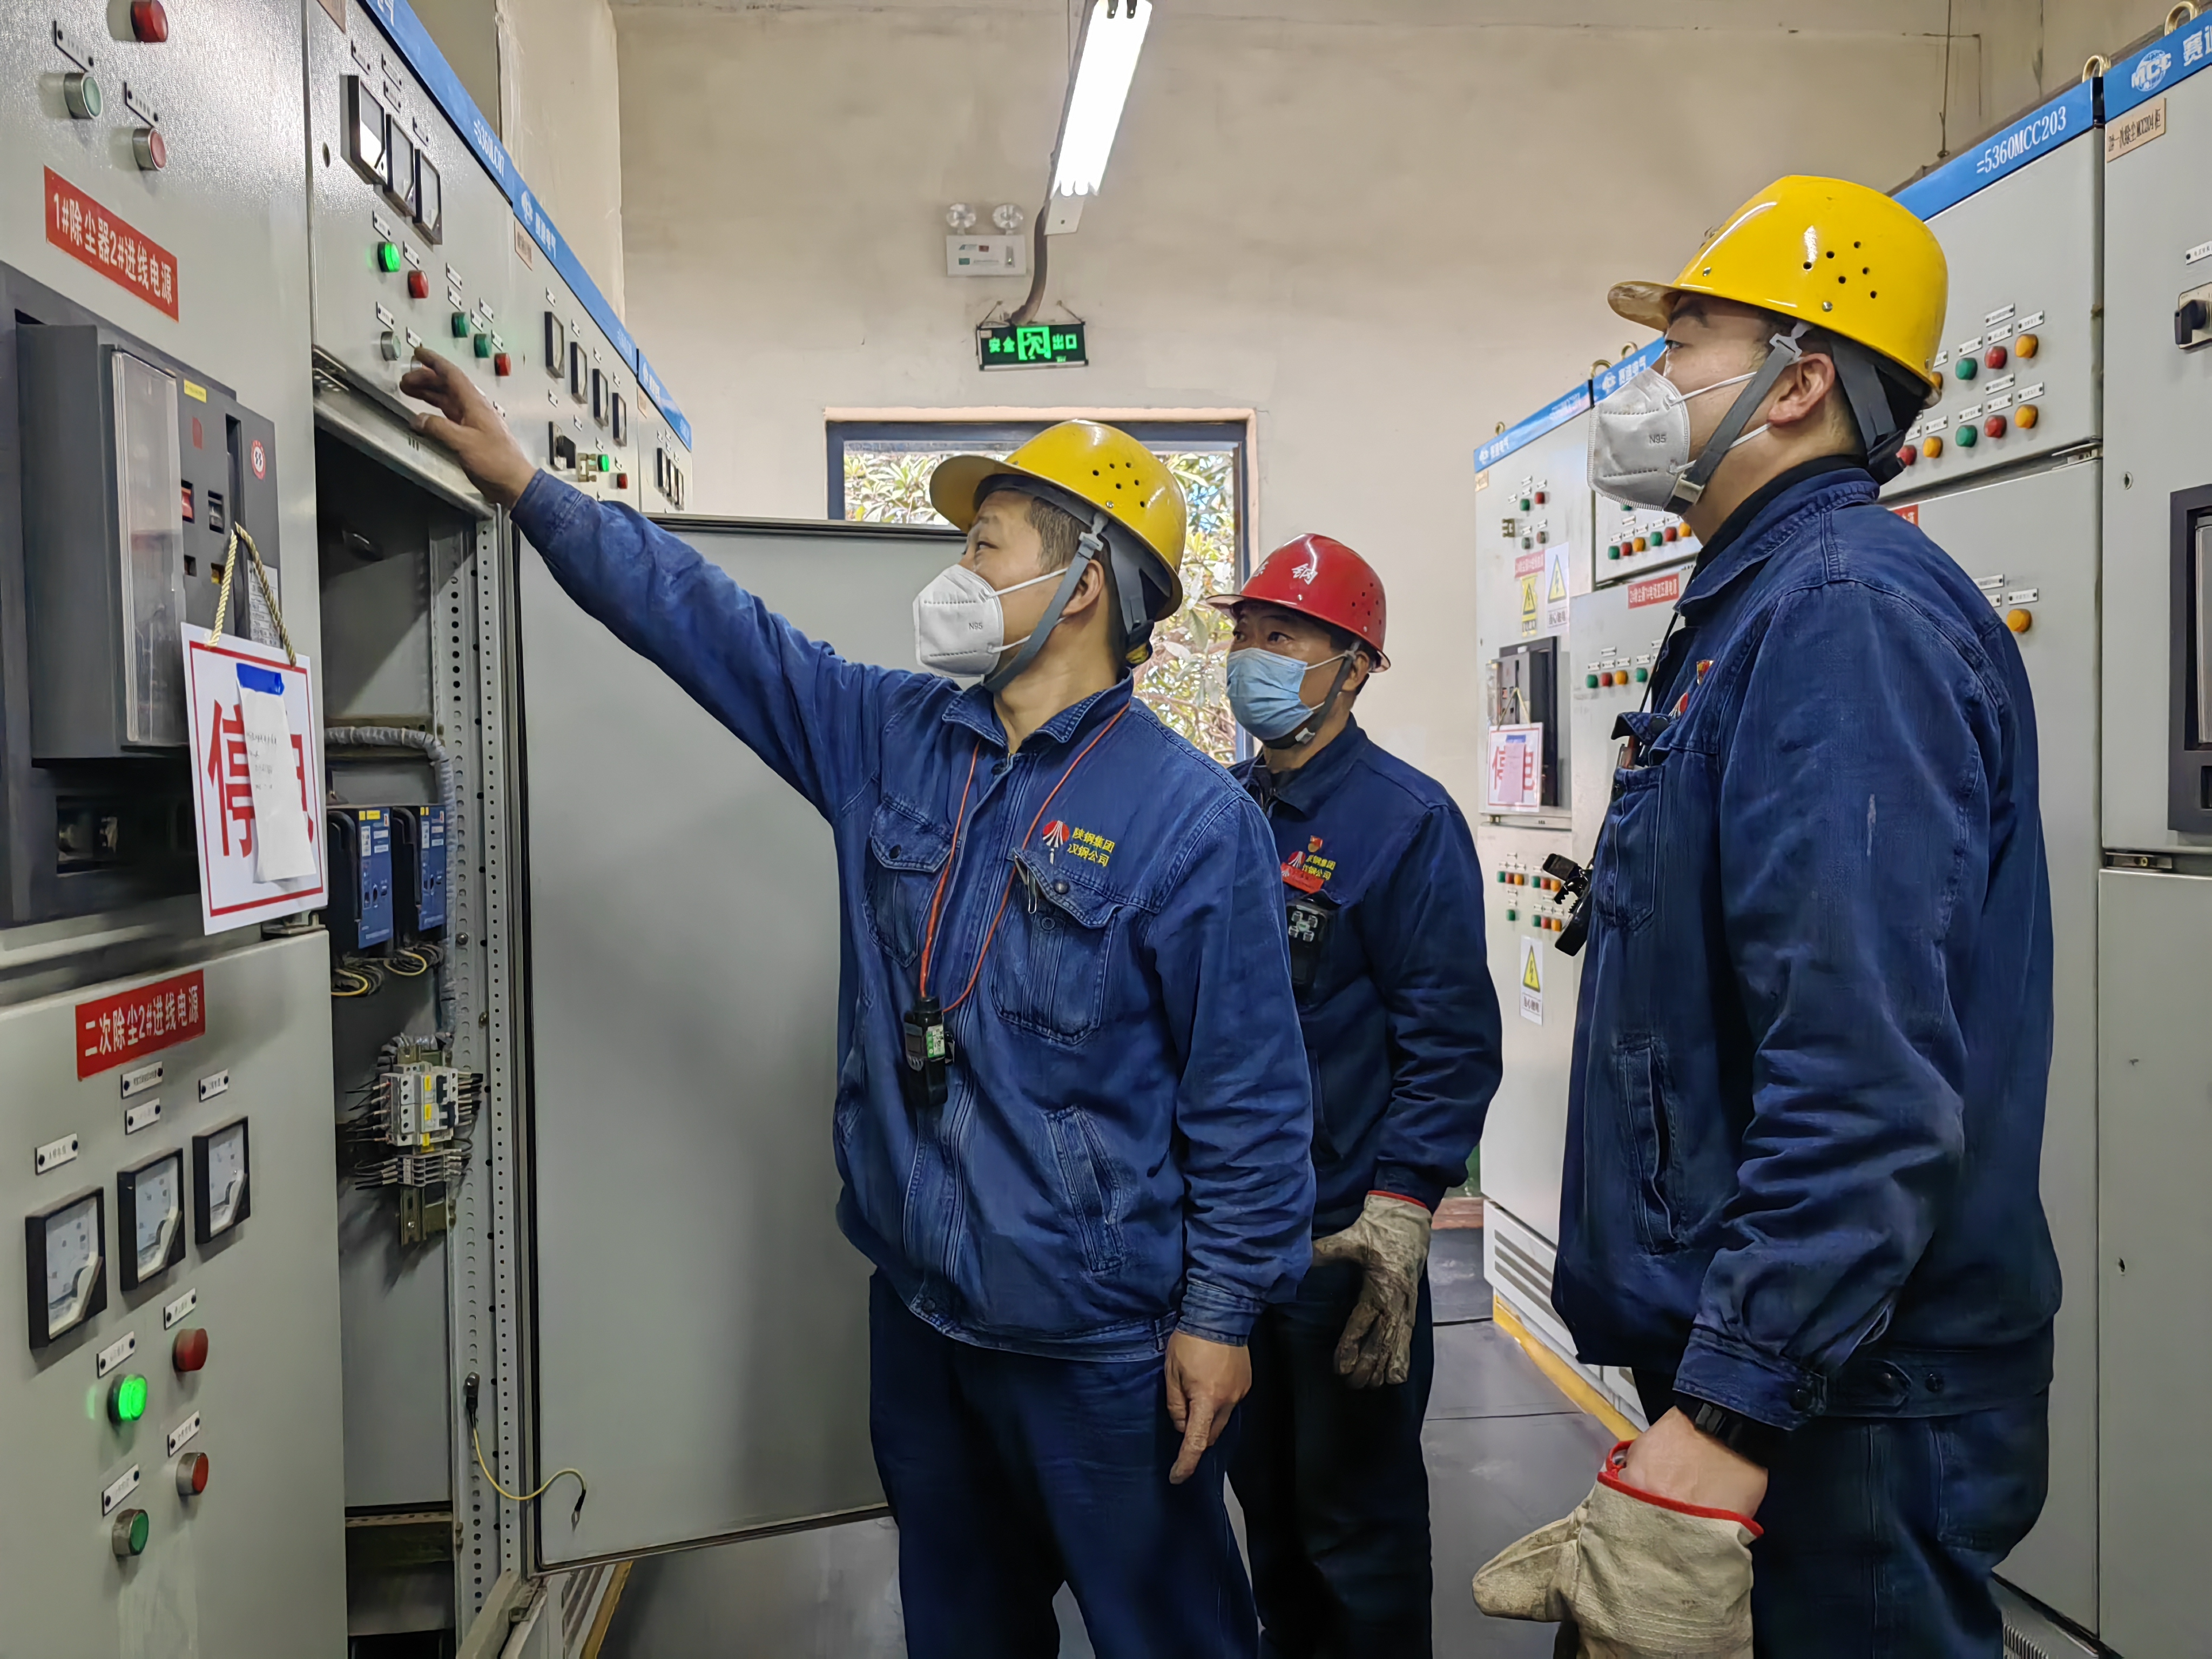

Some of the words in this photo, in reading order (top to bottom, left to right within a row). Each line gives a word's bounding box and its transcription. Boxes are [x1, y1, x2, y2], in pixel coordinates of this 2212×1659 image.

[2131, 52, 2171, 88] MCC
[1977, 106, 2067, 173] =5360MCC203
[53, 192, 172, 306] 1#除尘器2#进线电源
[989, 336, 1015, 353] 安全
[1053, 333, 1077, 350] 出口
[1649, 434, 1667, 444] N95
[207, 698, 314, 859] 停
[1067, 843, 1110, 867] 汉钢公司
[1072, 827, 1116, 853] 陕钢集团
[85, 984, 199, 1057] 二次除尘2#进线电源
